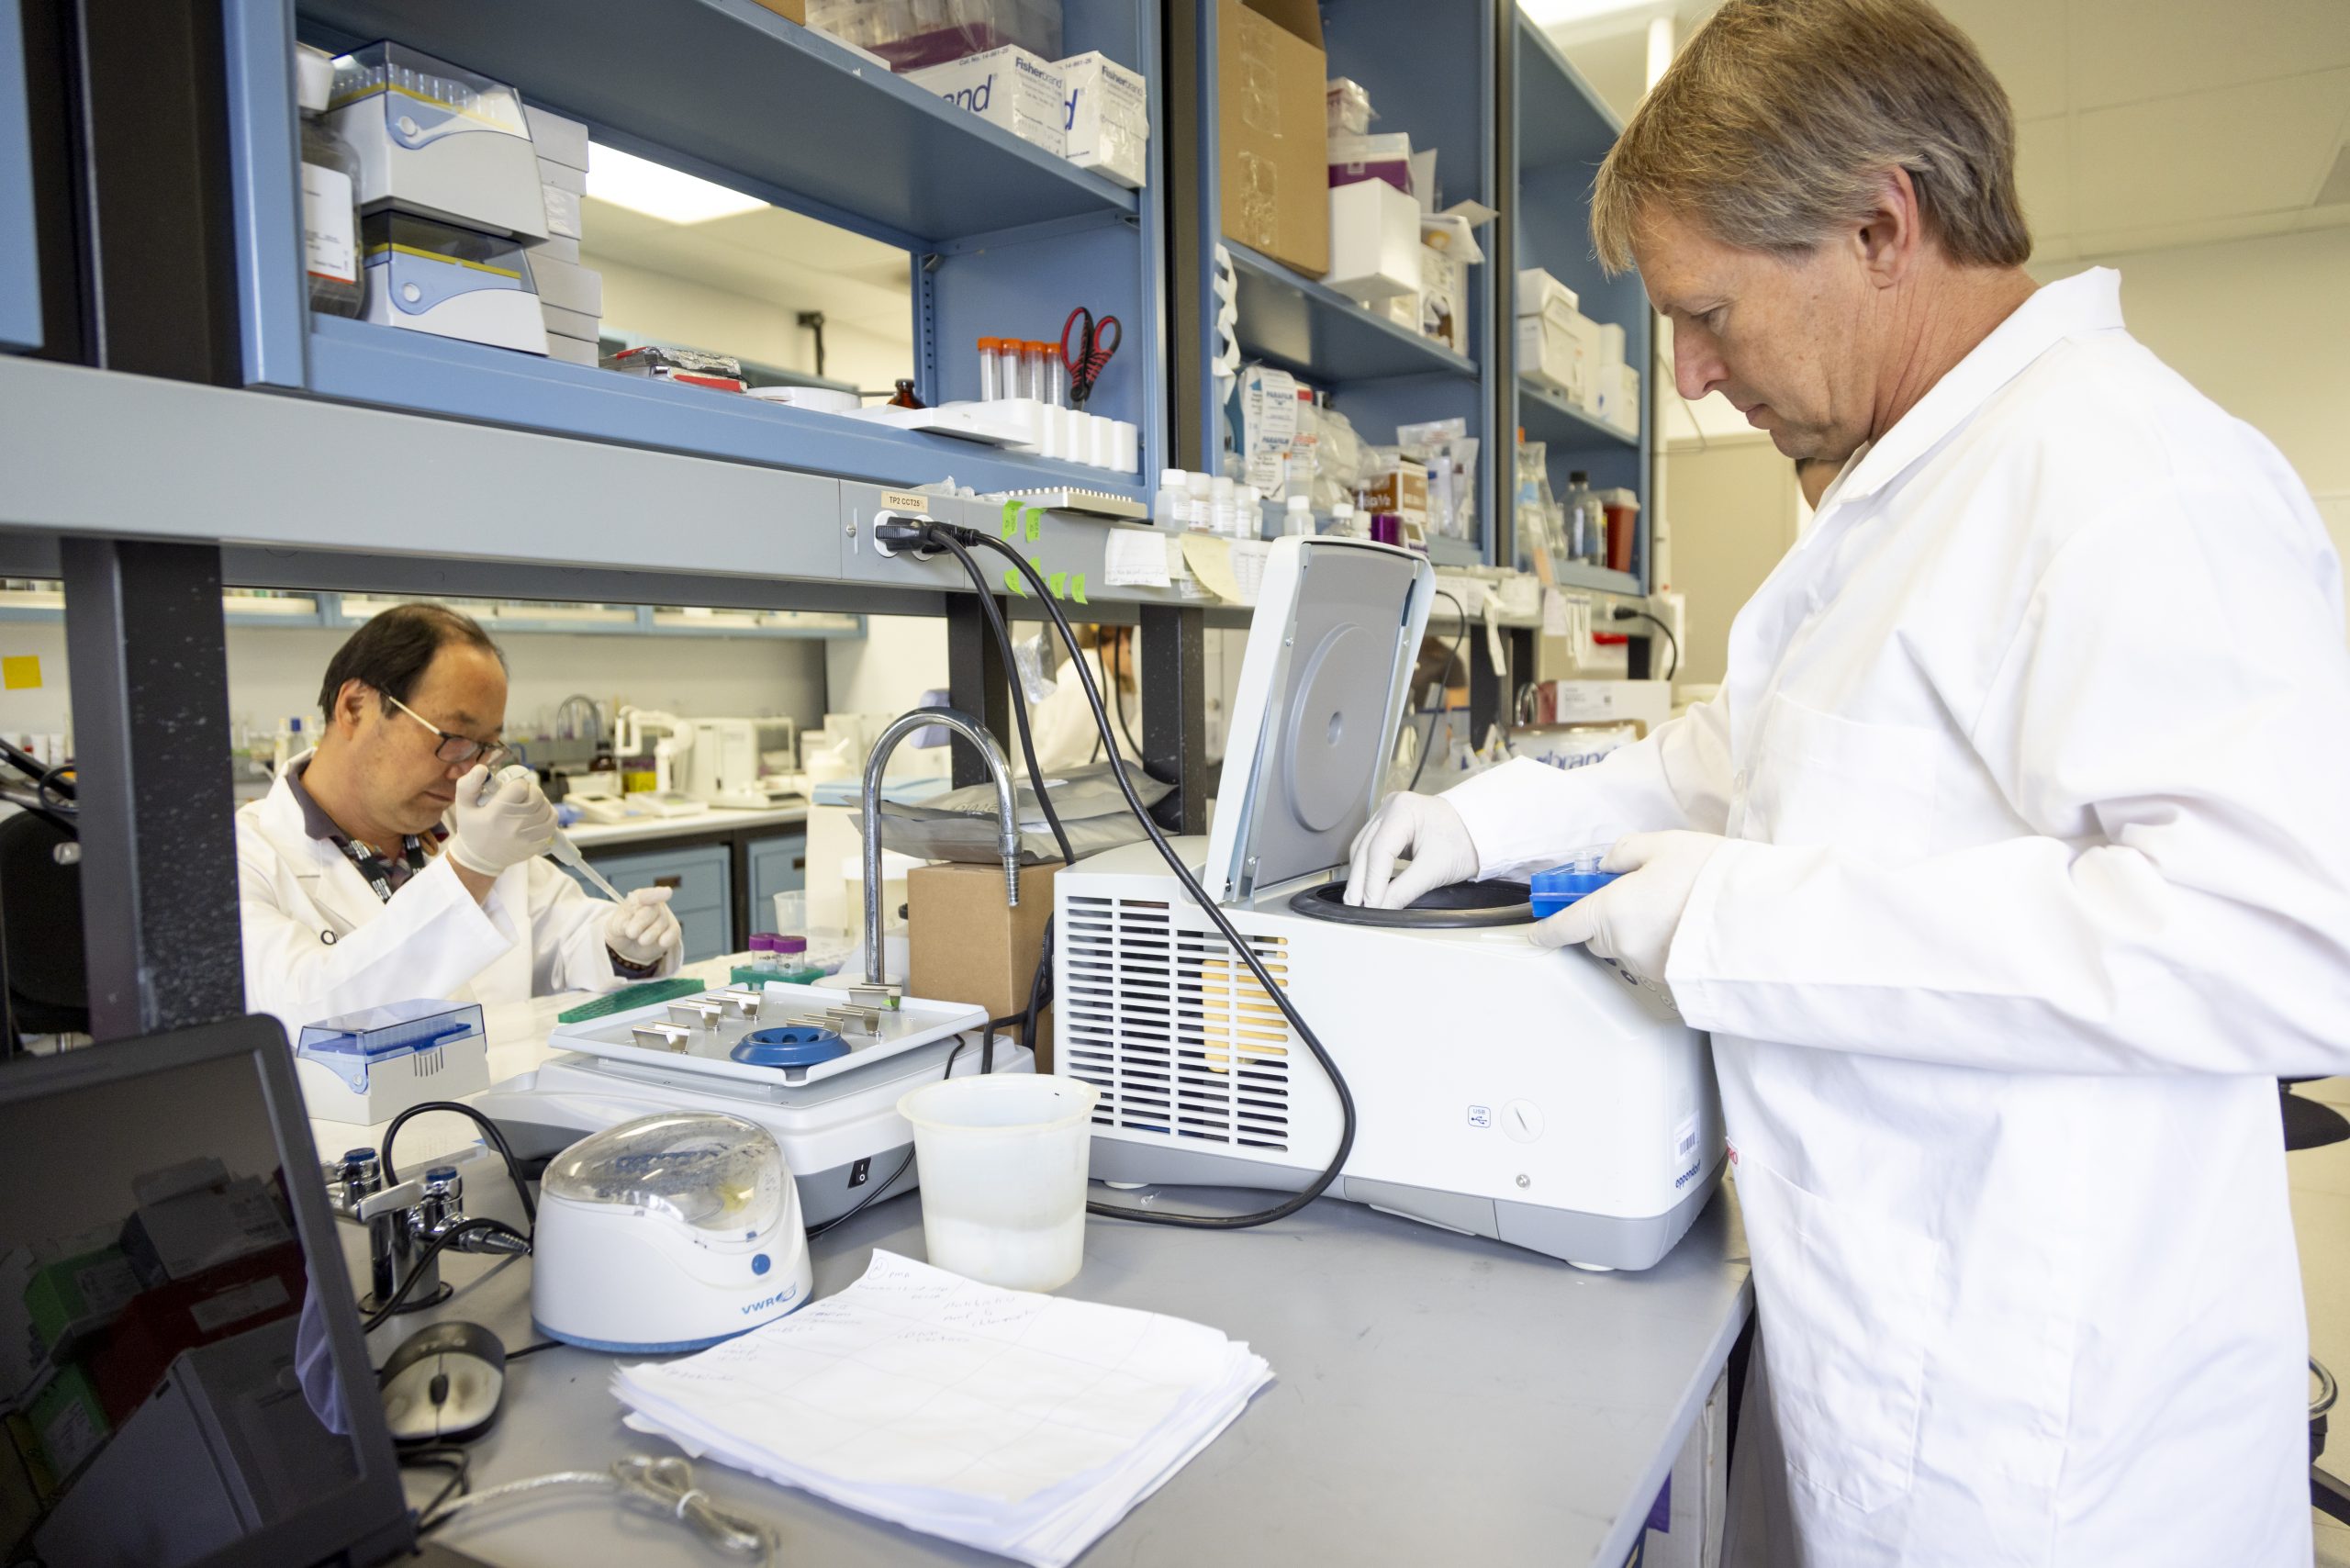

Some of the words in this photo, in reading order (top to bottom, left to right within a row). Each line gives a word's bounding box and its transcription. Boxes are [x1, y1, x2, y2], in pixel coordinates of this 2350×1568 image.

[1015, 56, 1063, 89] Fisherbrand
[889, 496, 901, 505] TP2
[1675, 1159, 1701, 1190] eppendorf
[742, 1296, 775, 1315] VWR
